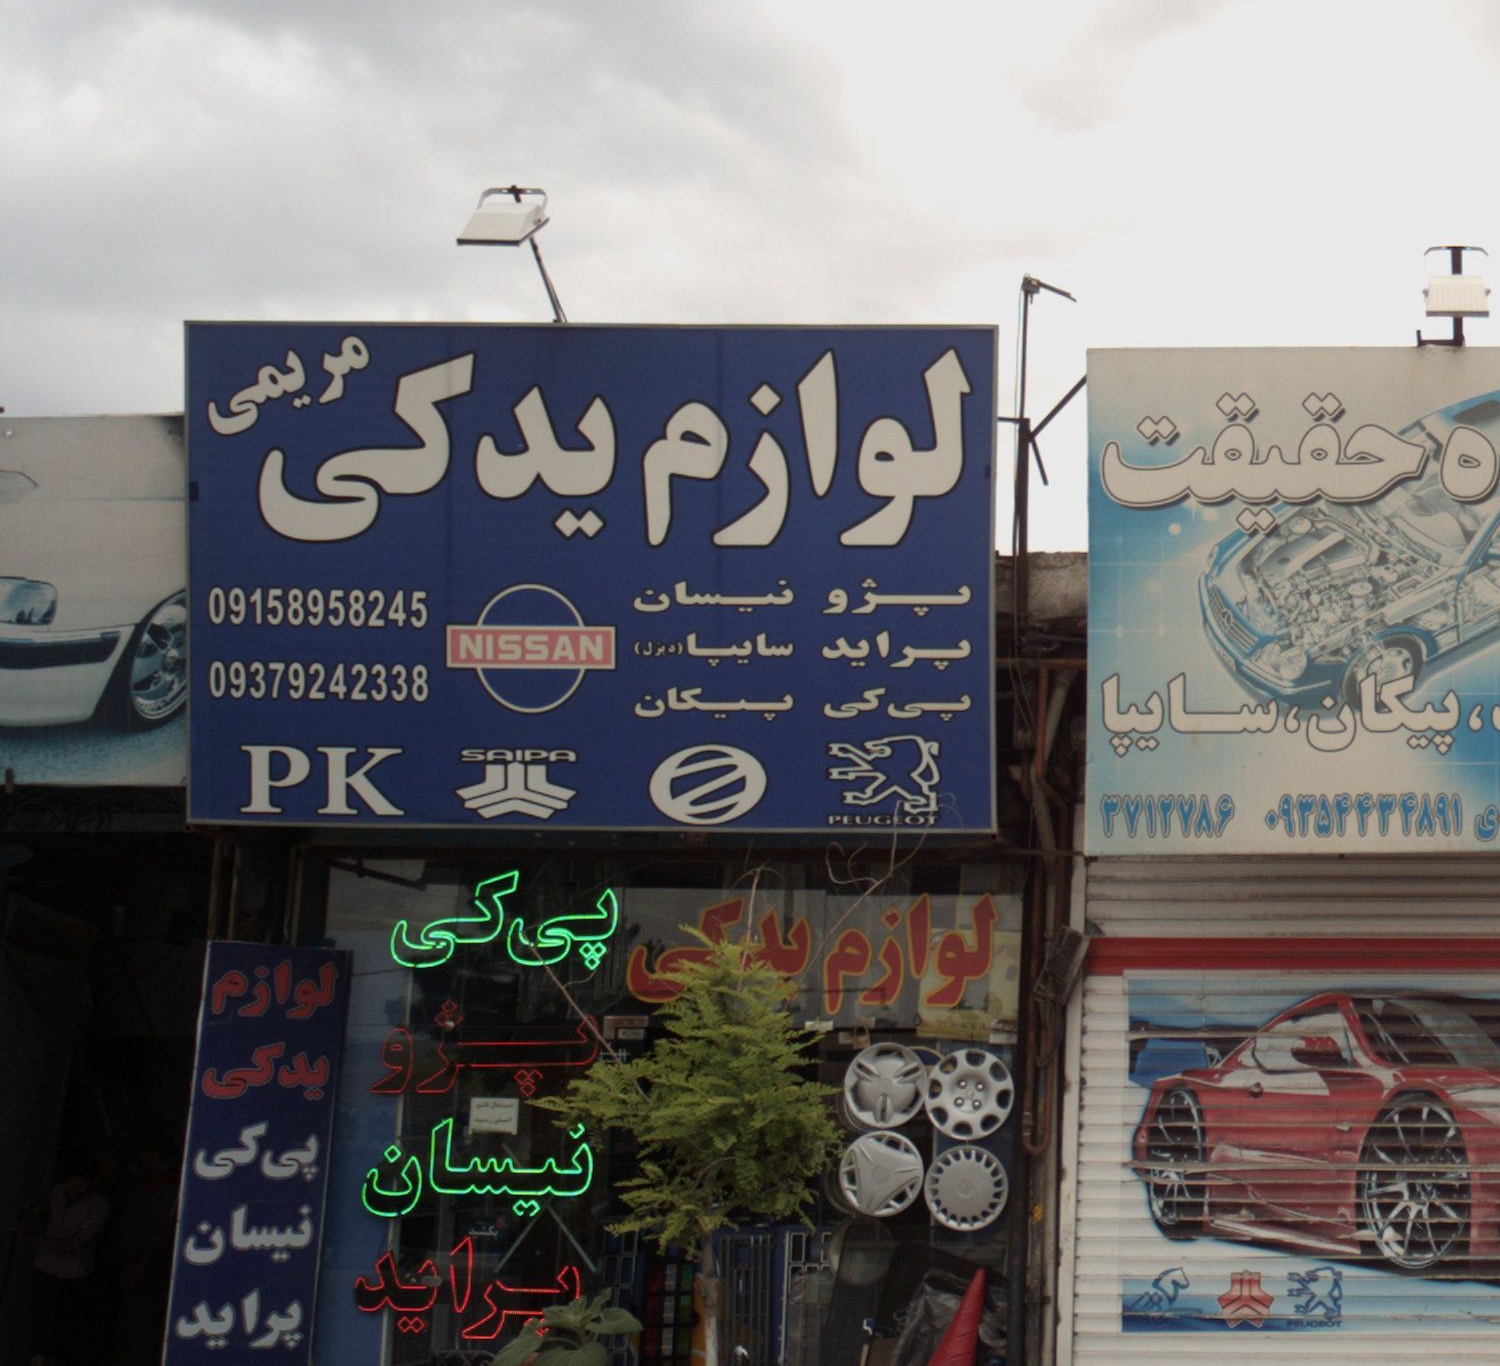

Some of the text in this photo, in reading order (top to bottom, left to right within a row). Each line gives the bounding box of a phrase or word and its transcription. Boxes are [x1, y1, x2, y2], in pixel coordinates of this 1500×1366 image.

[206, 334, 370, 437] مریمی
[257, 346, 974, 547] لوازم یدکی
[1100, 390, 1430, 534] حقیقت
[207, 586, 429, 629] 09158958245
[634, 579, 794, 612] نیسان
[823, 577, 972, 617] پژو
[458, 633, 604, 662] NISSAN
[686, 632, 794, 667] سایپا
[822, 630, 972, 670] پراید
[208, 660, 430, 704] 09379242338
[634, 686, 794, 721] پیکان
[1100, 670, 1279, 758] سایپا
[239, 743, 406, 817] PK
[460, 747, 577, 764] SAIPA
[827, 815, 939, 826] PEUGEOT
[1101, 794, 1235, 838] ۳۷۱۲۷۸۶
[823, 891, 999, 1015] لوازم
[212, 959, 339, 1019] لوازم
[201, 1042, 330, 1101] یدکی
[370, 998, 599, 1097] پژو
[361, 1117, 595, 1219] نیسان
[182, 1203, 314, 1266] نیسان
[354, 1235, 582, 1340] پراید
[174, 1287, 304, 1351] پراید
